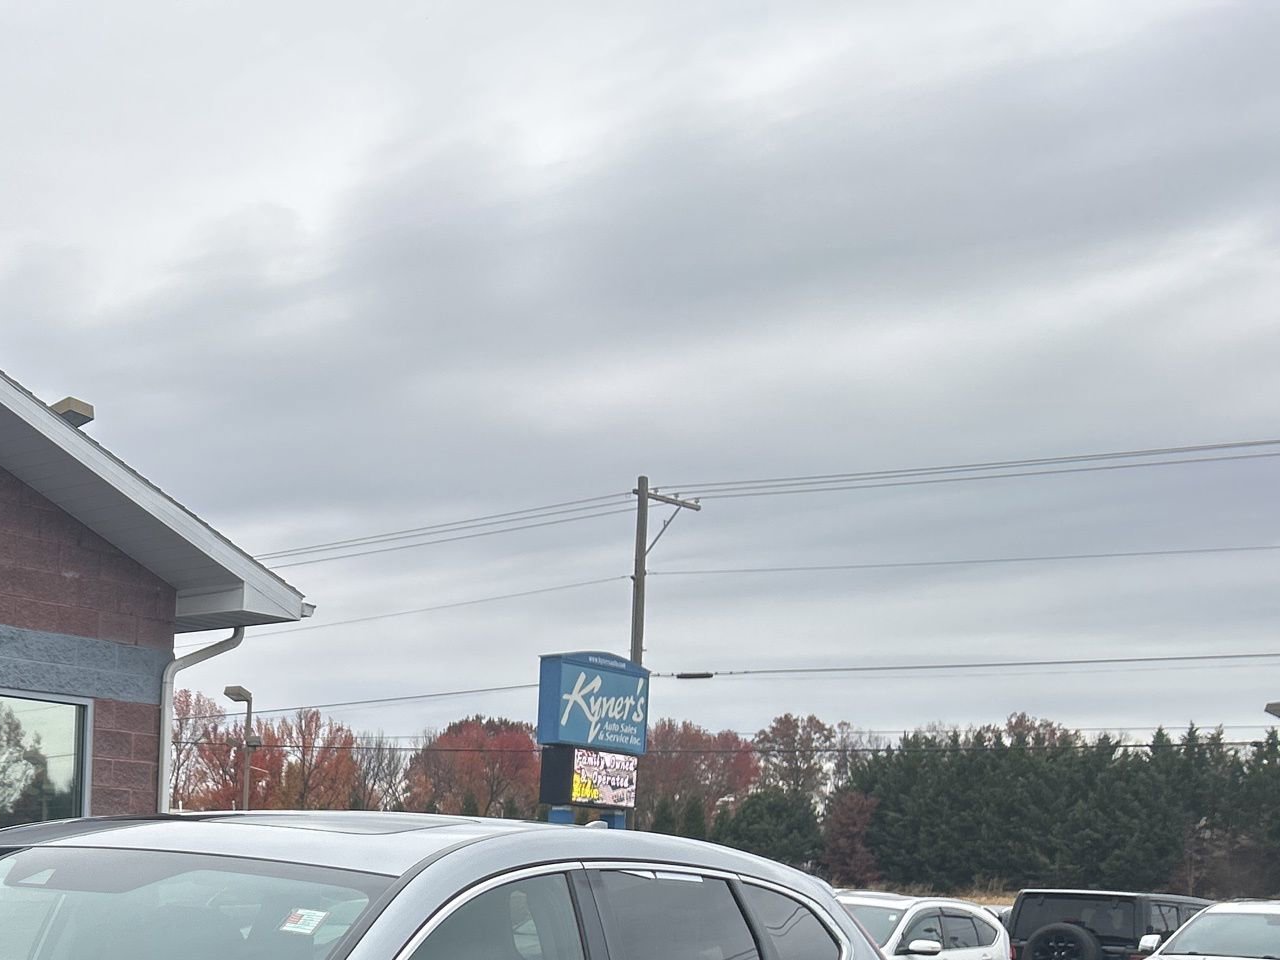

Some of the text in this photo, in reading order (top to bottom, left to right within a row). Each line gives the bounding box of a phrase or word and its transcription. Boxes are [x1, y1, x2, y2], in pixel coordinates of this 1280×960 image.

[561, 671, 645, 743] Kyner's
[603, 721, 637, 735] Auto Sales
[598, 730, 605, 741] &
[605, 731, 630, 744] Service
[577, 751, 635, 771] Family Owned
[592, 771, 630, 788] Operated
